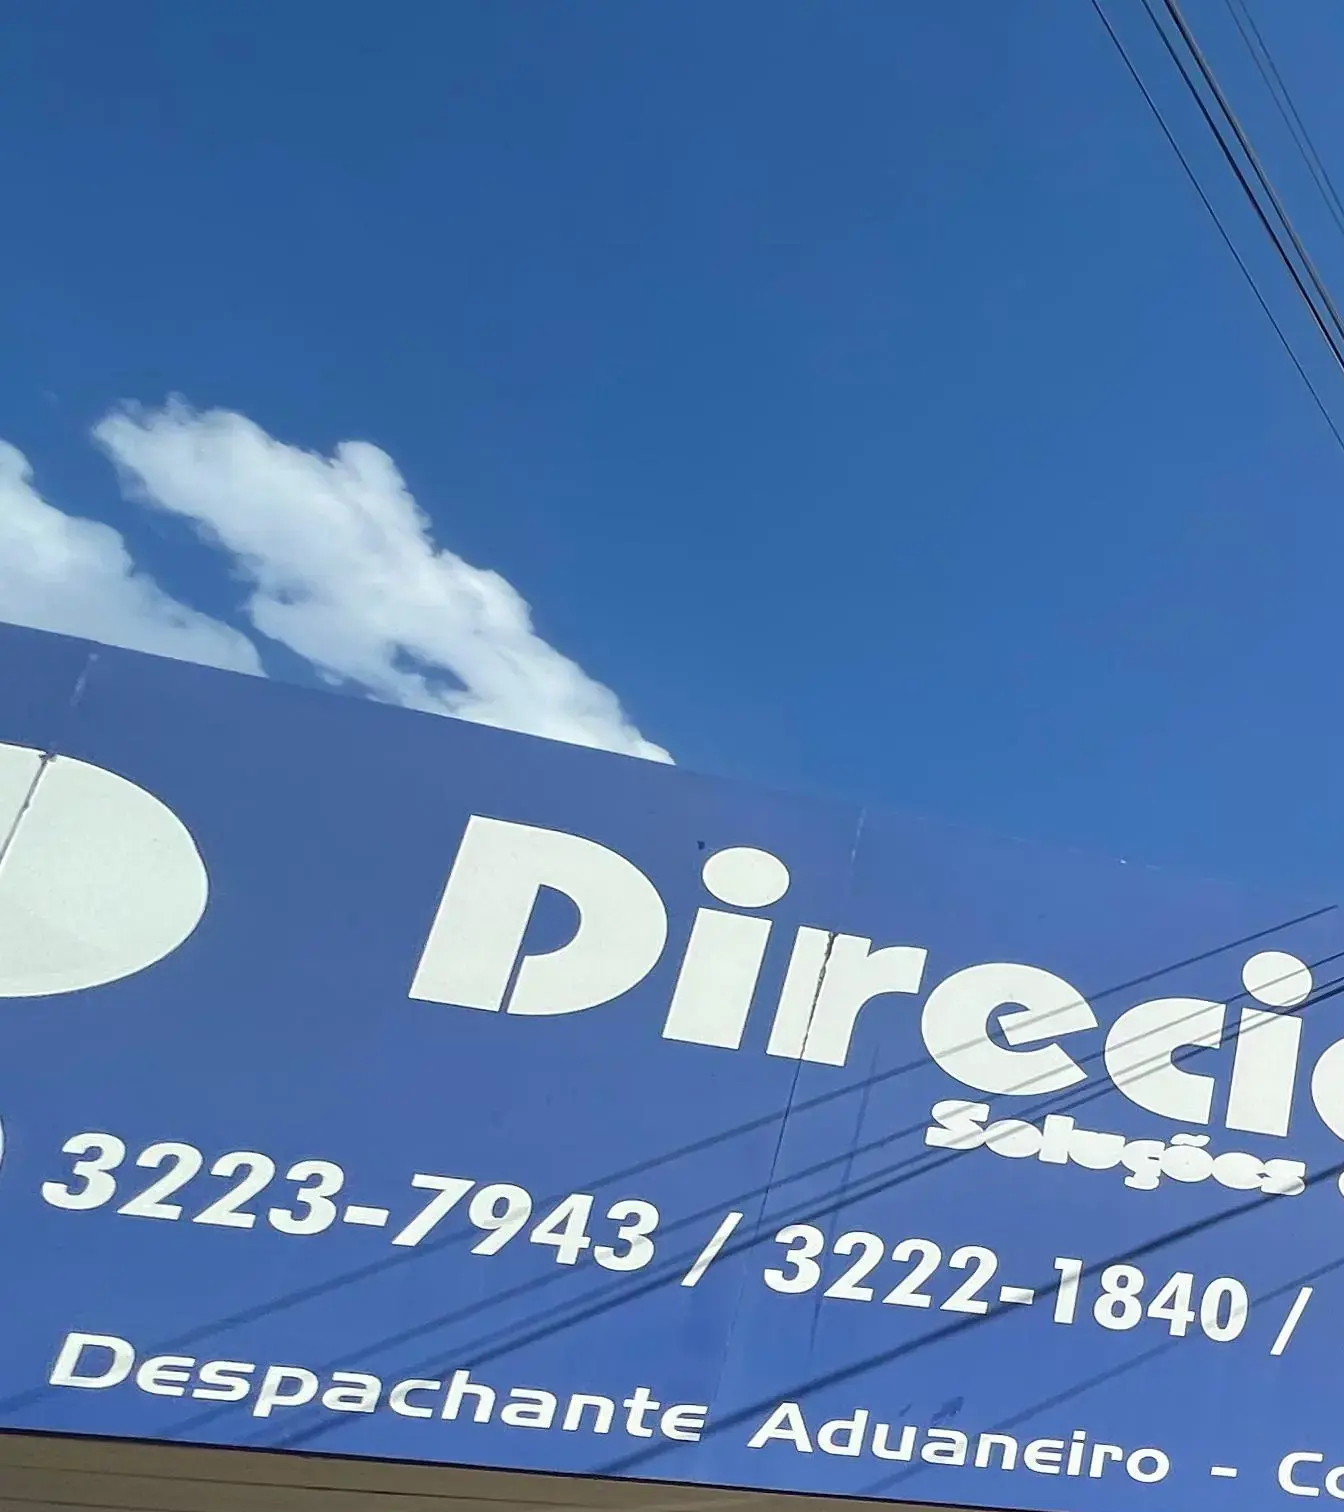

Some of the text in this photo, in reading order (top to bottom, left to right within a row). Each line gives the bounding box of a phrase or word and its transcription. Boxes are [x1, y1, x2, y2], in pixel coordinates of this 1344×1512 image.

[924, 1099, 1307, 1196] Soluções
[41, 1132, 659, 1271] 3223-7943
[681, 1212, 744, 1287] /
[764, 1224, 1248, 1342] 3222-1840
[1270, 1287, 1313, 1356] /
[49, 1332, 708, 1442] Despachante
[747, 1402, 1170, 1483] Aduaneiro
[1210, 1466, 1238, 1478] -
